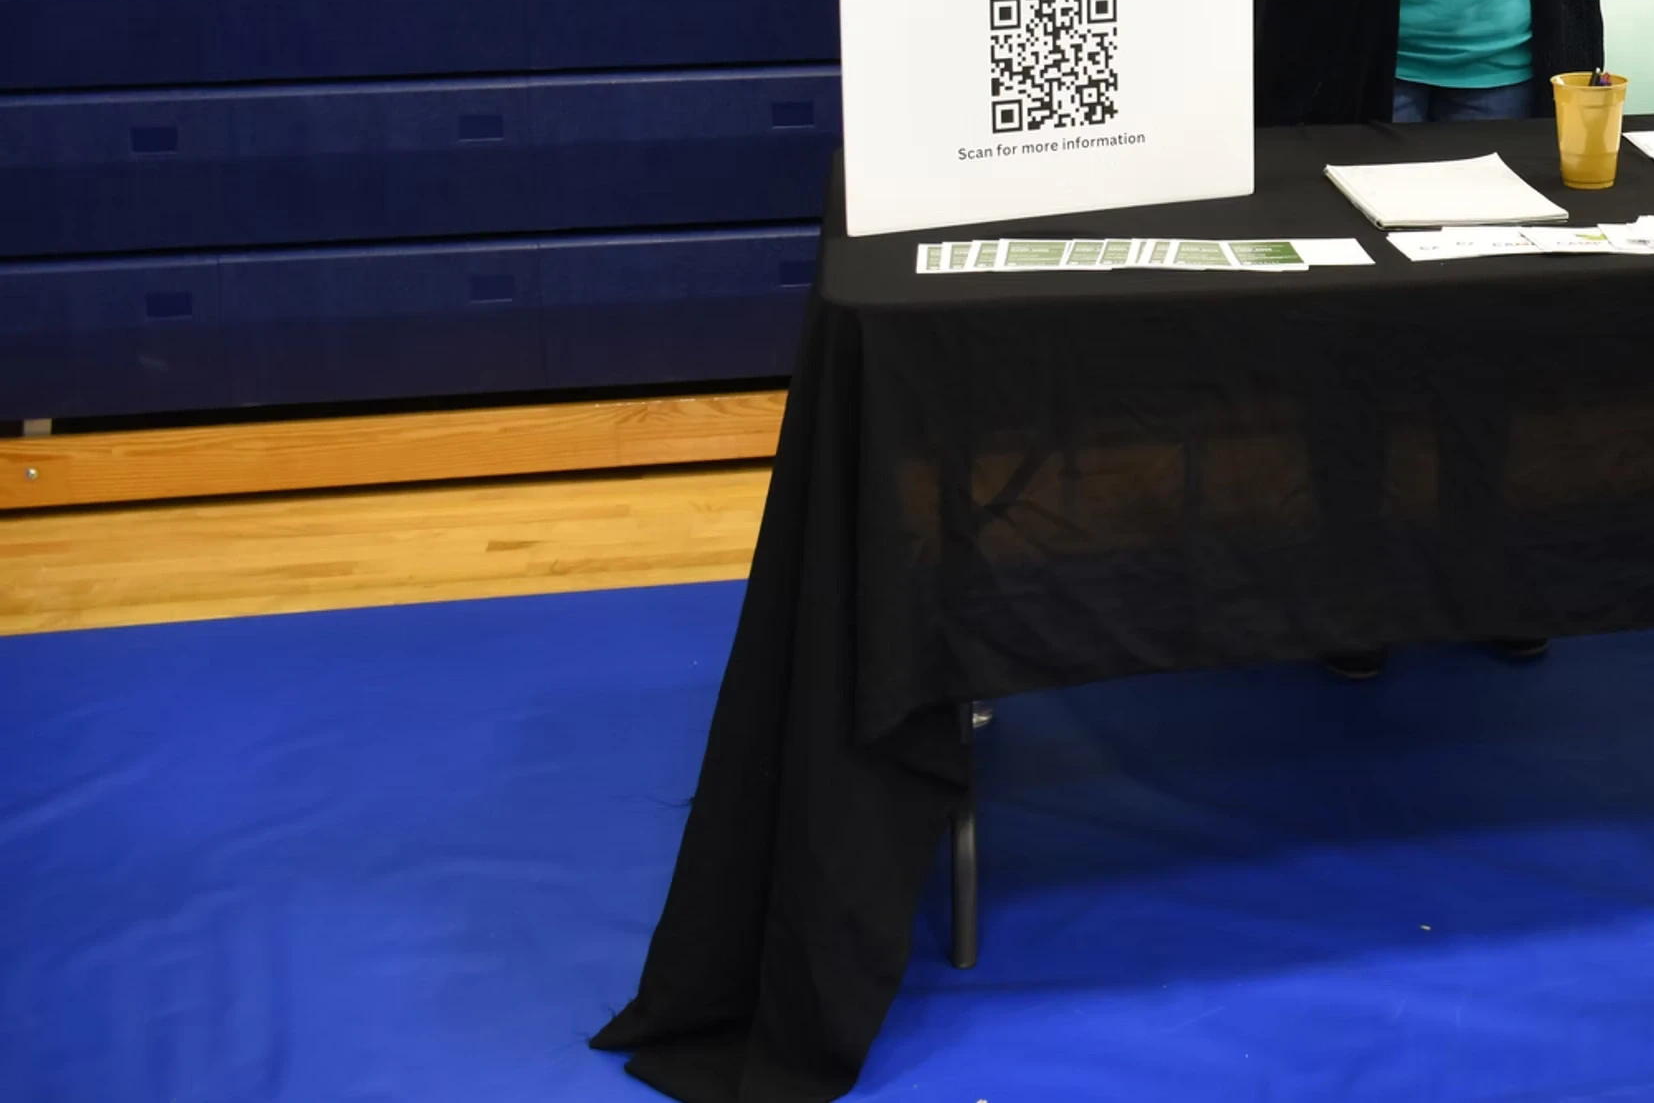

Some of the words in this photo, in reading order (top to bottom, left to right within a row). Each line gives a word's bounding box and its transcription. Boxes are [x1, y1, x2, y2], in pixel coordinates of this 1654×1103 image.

[957, 146, 993, 161] Scan
[997, 143, 1018, 157] for
[1021, 141, 1059, 154] more
[1062, 132, 1146, 151] information
